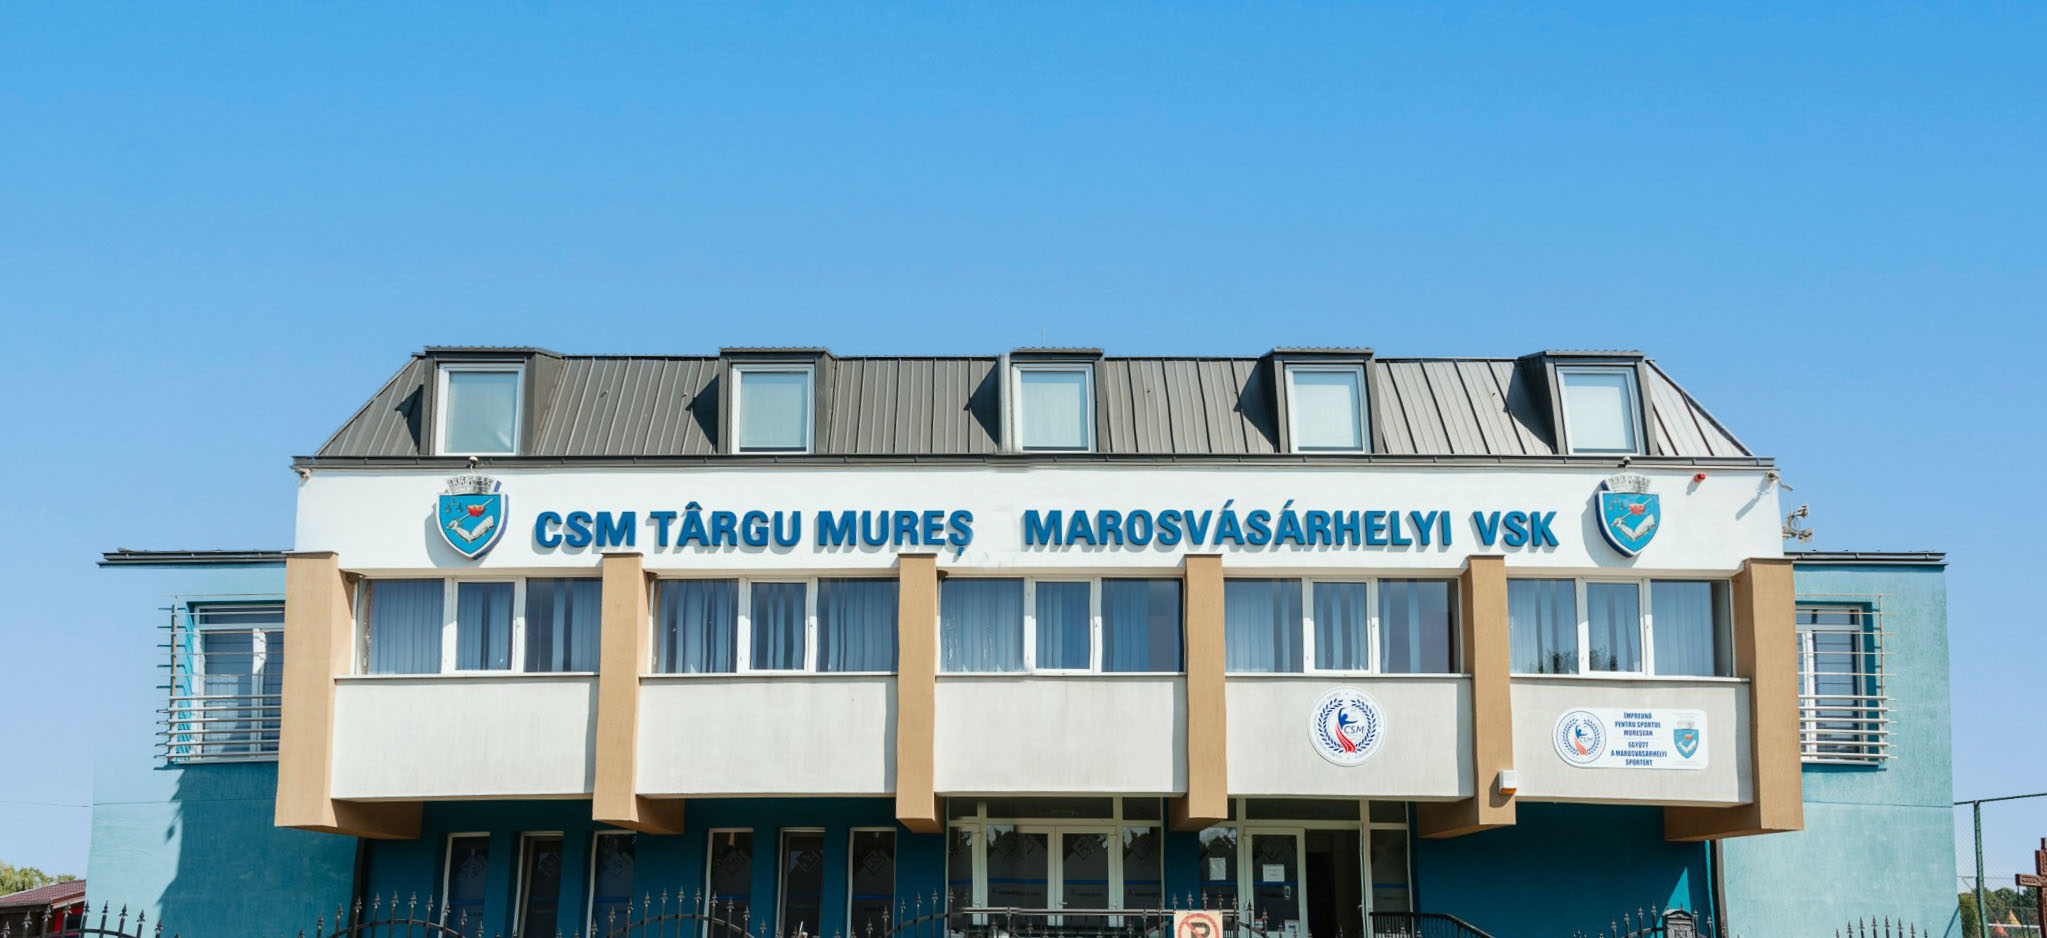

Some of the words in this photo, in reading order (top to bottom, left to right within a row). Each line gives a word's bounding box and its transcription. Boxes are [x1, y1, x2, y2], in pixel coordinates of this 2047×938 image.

[534, 511, 636, 548] CSM
[649, 501, 802, 548] TÂRGU
[817, 510, 974, 557] MUREȘ
[1024, 499, 1452, 547] MAROSVÁSÁRHELYI
[1472, 511, 1559, 547] VSK
[1344, 725, 1365, 734] CSM
